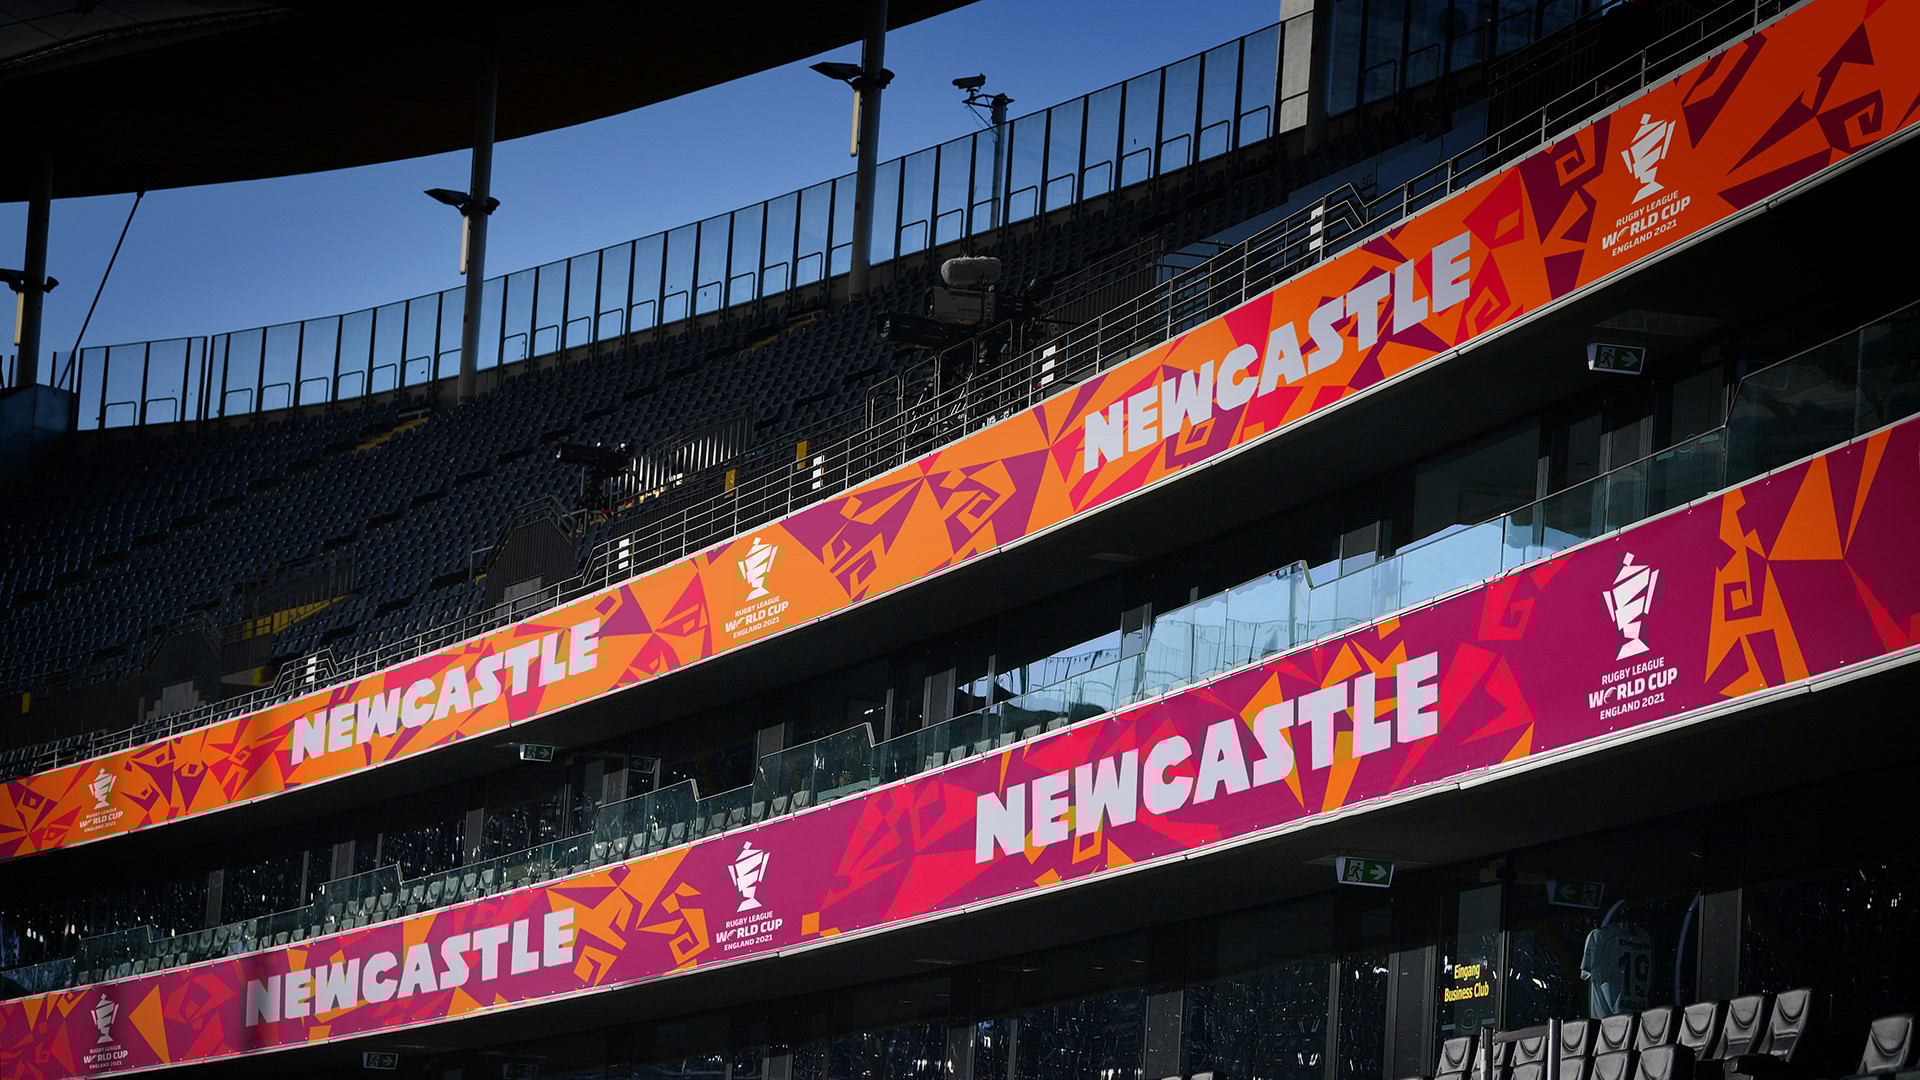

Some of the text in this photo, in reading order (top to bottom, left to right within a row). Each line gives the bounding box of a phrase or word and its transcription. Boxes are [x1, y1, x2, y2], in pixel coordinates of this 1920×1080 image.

[1601, 195, 1691, 250] WORLD CUP
[1615, 190, 1679, 228] RUGBY LEAGUE
[1611, 219, 1678, 257] ENGLAND 2021
[1083, 231, 1471, 474] NEWCASTLE
[725, 600, 789, 633] WORLD CUP
[734, 595, 780, 617] RUGBY LEAGUE
[733, 616, 780, 639] ENGLAND 2021
[1601, 656, 1665, 686] RUGBY LEAGUE
[291, 618, 600, 764] NEWCASTLE
[1588, 667, 1678, 709] WORLD CUP
[1599, 692, 1665, 721] ENGLAND 2021
[975, 653, 1439, 863] NEWCASTLE
[108, 811, 124, 821] CUP
[715, 918, 783, 943] WORLD CUP
[726, 910, 773, 929] RUGBY LEAGUE
[723, 934, 773, 951] ENGLAND 2021
[245, 908, 575, 1027] NEWCASTLE
[1454, 964, 1480, 981] Eingang
[1444, 981, 1489, 1002] Business Club
[112, 1050, 128, 1059] CUP
